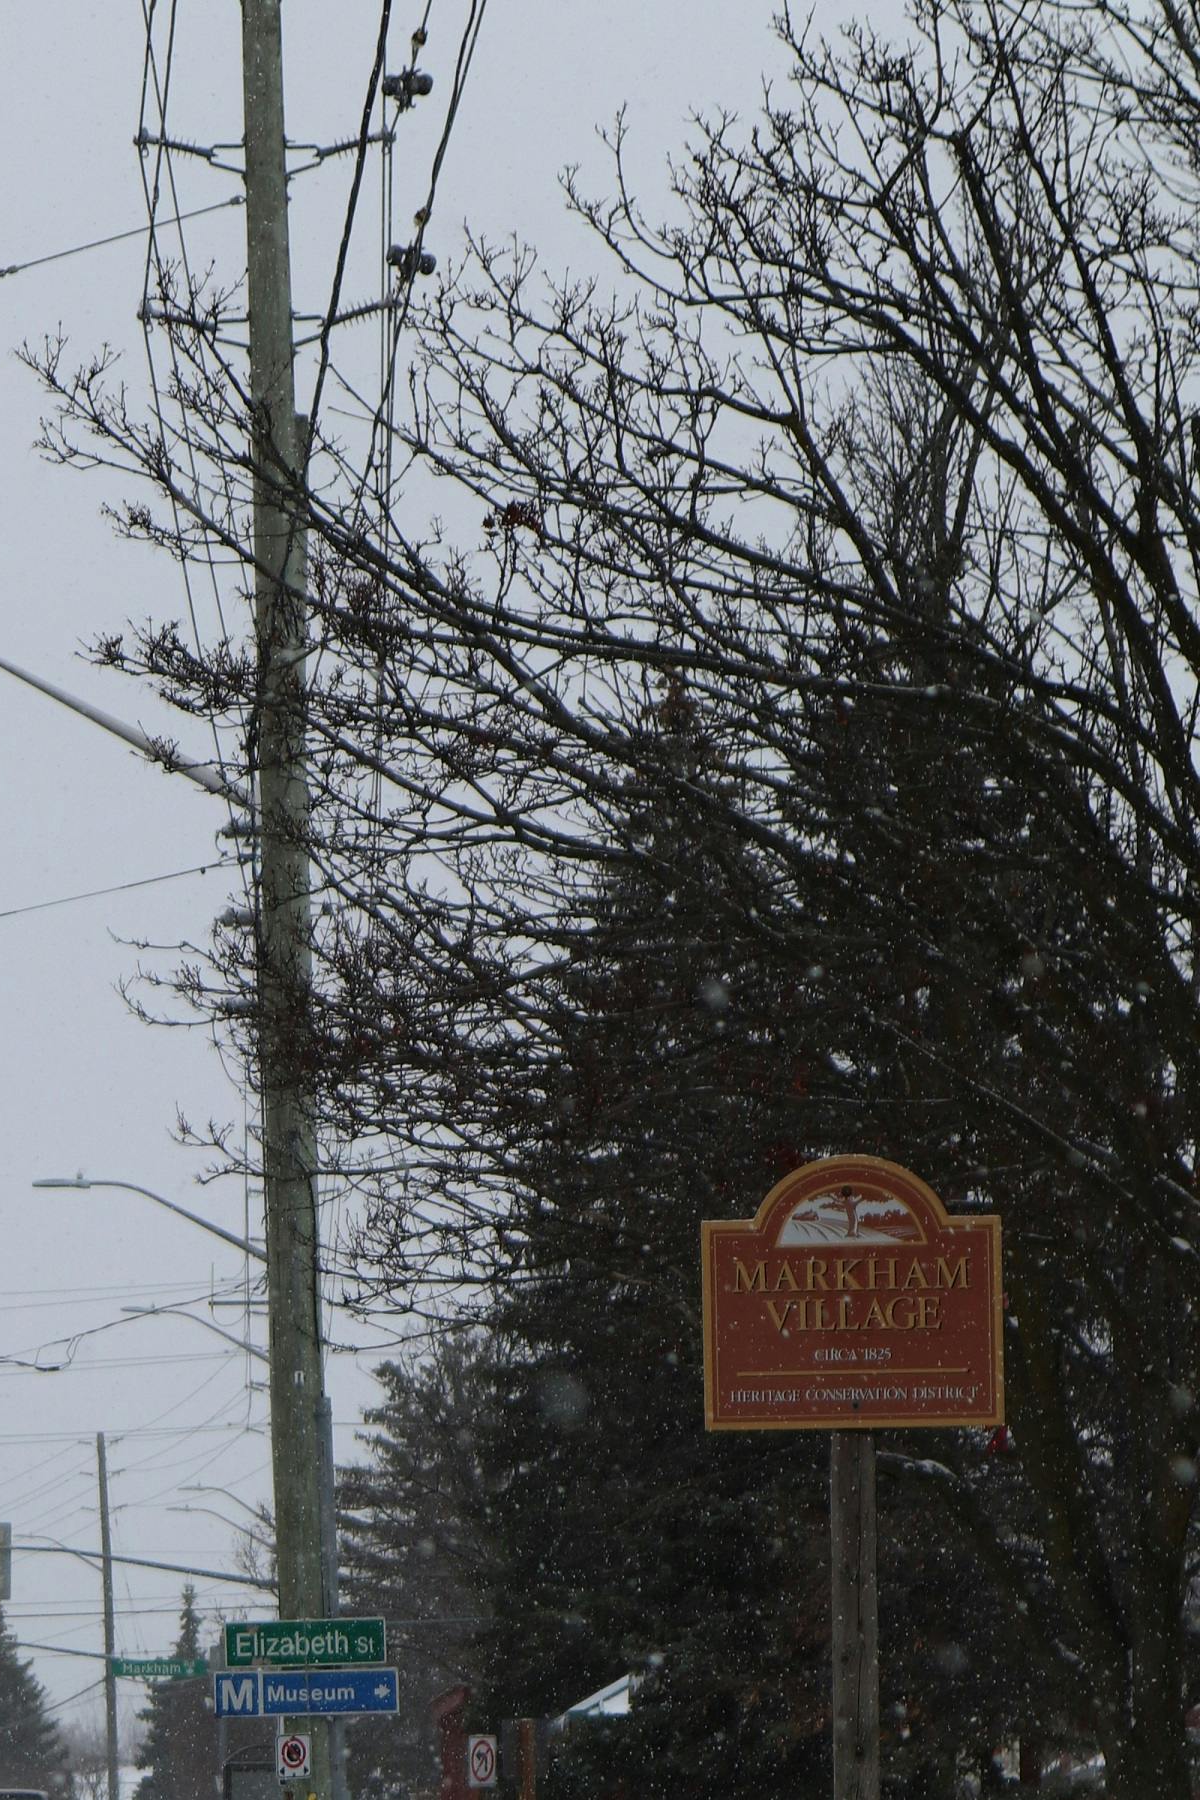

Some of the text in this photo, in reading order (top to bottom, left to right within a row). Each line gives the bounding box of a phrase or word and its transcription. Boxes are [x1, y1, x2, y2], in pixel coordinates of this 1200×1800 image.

[732, 1256, 972, 1293] MARKHAM
[766, 1296, 944, 1332] VILLAGE
[814, 1347, 892, 1361] CIRCA 1825
[730, 1383, 979, 1402] HERITAGE CONSERVATION DISTRICT
[236, 1630, 375, 1657] Elizabeth St
[122, 1662, 181, 1675] Markham
[221, 1679, 355, 1712] M Museum
